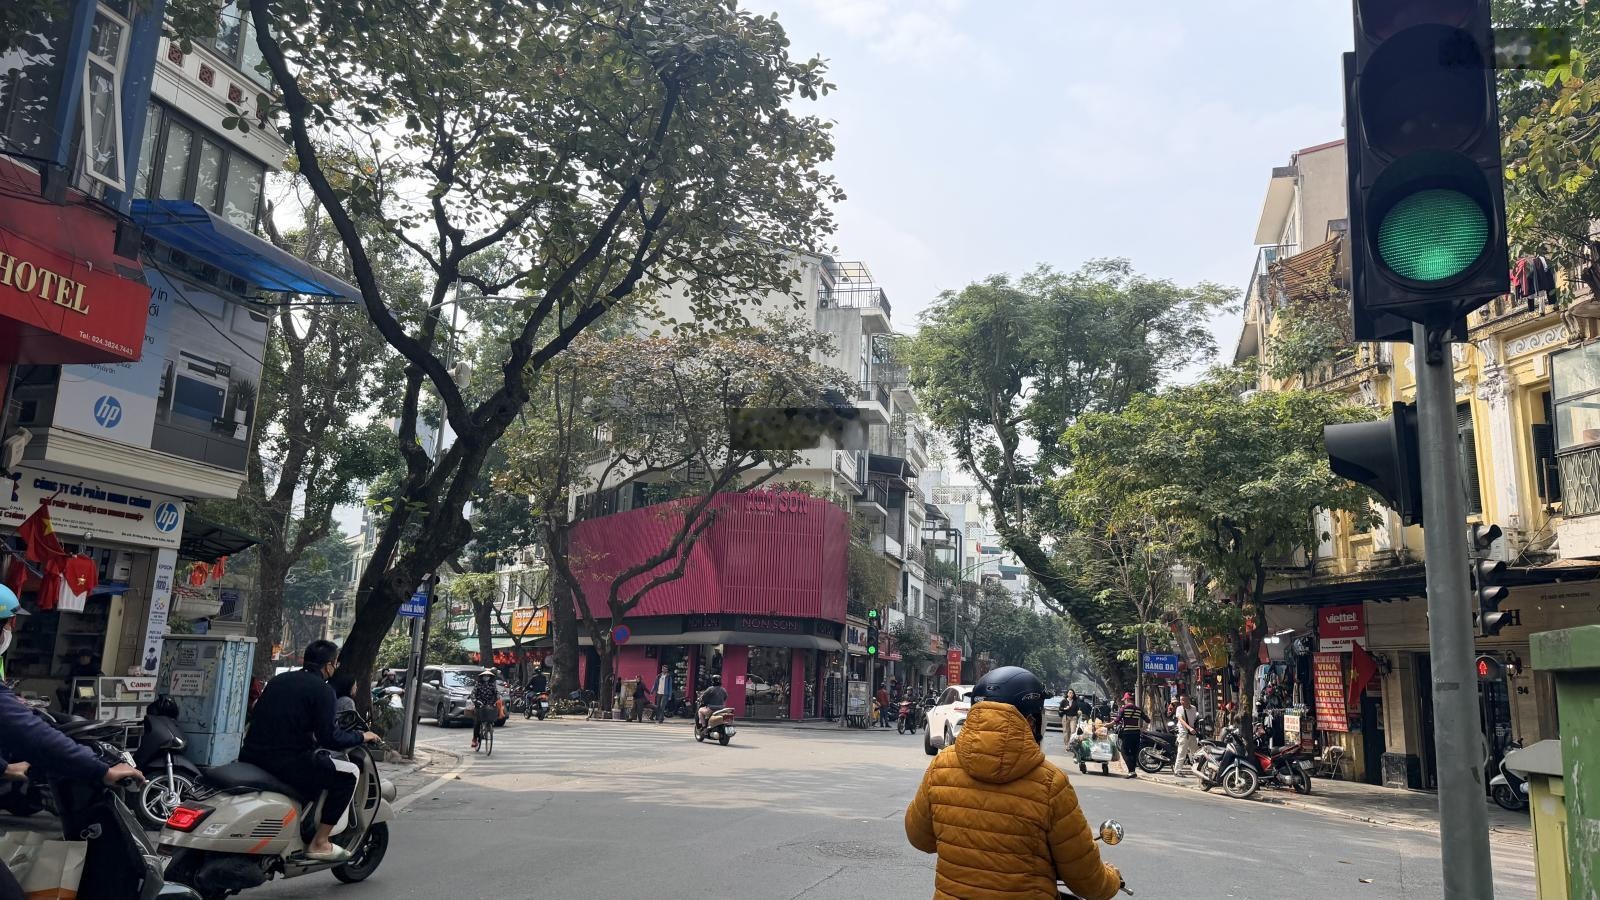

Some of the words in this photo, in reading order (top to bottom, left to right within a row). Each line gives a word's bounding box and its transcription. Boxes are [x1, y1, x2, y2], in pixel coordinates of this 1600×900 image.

[0, 251, 90, 315] HOTEL
[96, 396, 121, 428] hp
[156, 502, 178, 532] hp
[1326, 612, 1358, 623] viettel
[1318, 663, 1338, 671] VINA
[1318, 676, 1340, 684] MOBI
[1517, 687, 1530, 695] 94
